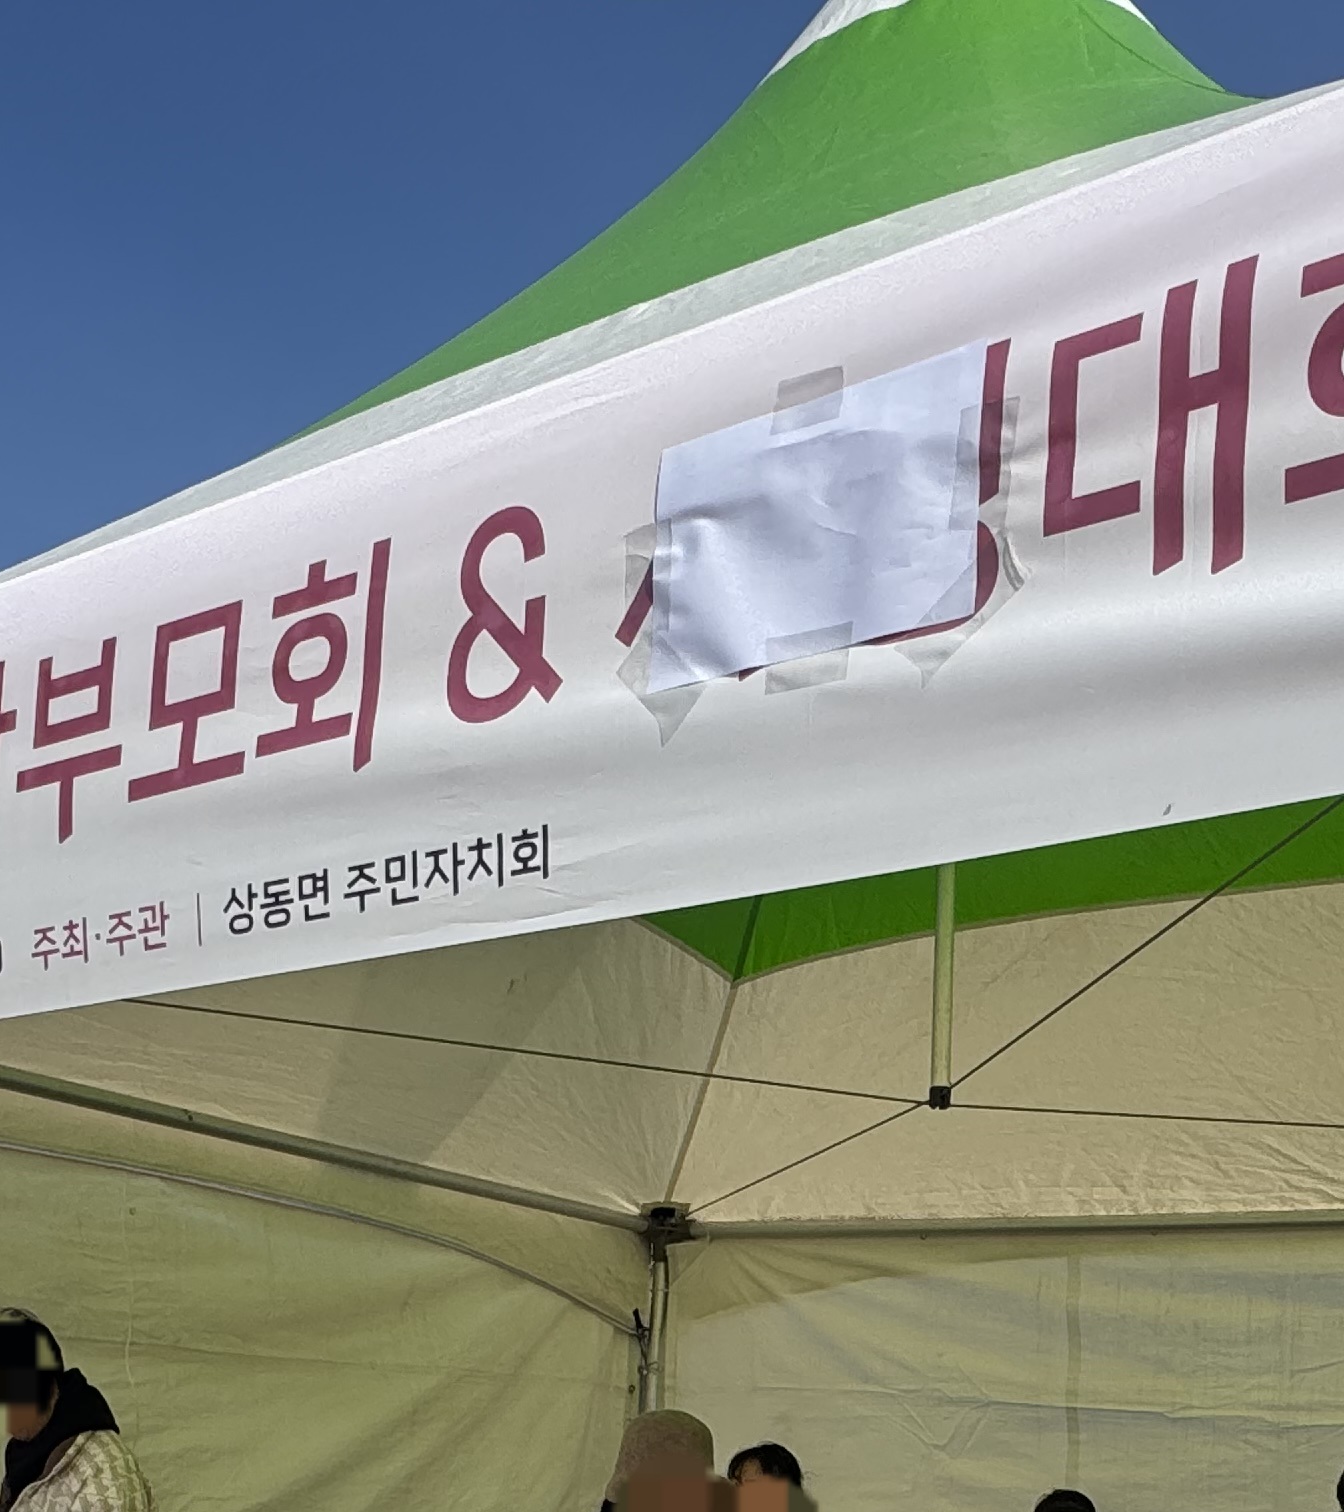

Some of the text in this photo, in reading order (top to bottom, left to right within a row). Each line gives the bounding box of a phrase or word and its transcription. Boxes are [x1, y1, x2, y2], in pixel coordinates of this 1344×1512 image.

[446, 506, 563, 723] &
[223, 870, 331, 936] 상동면
[343, 824, 551, 912] 주민자치회
